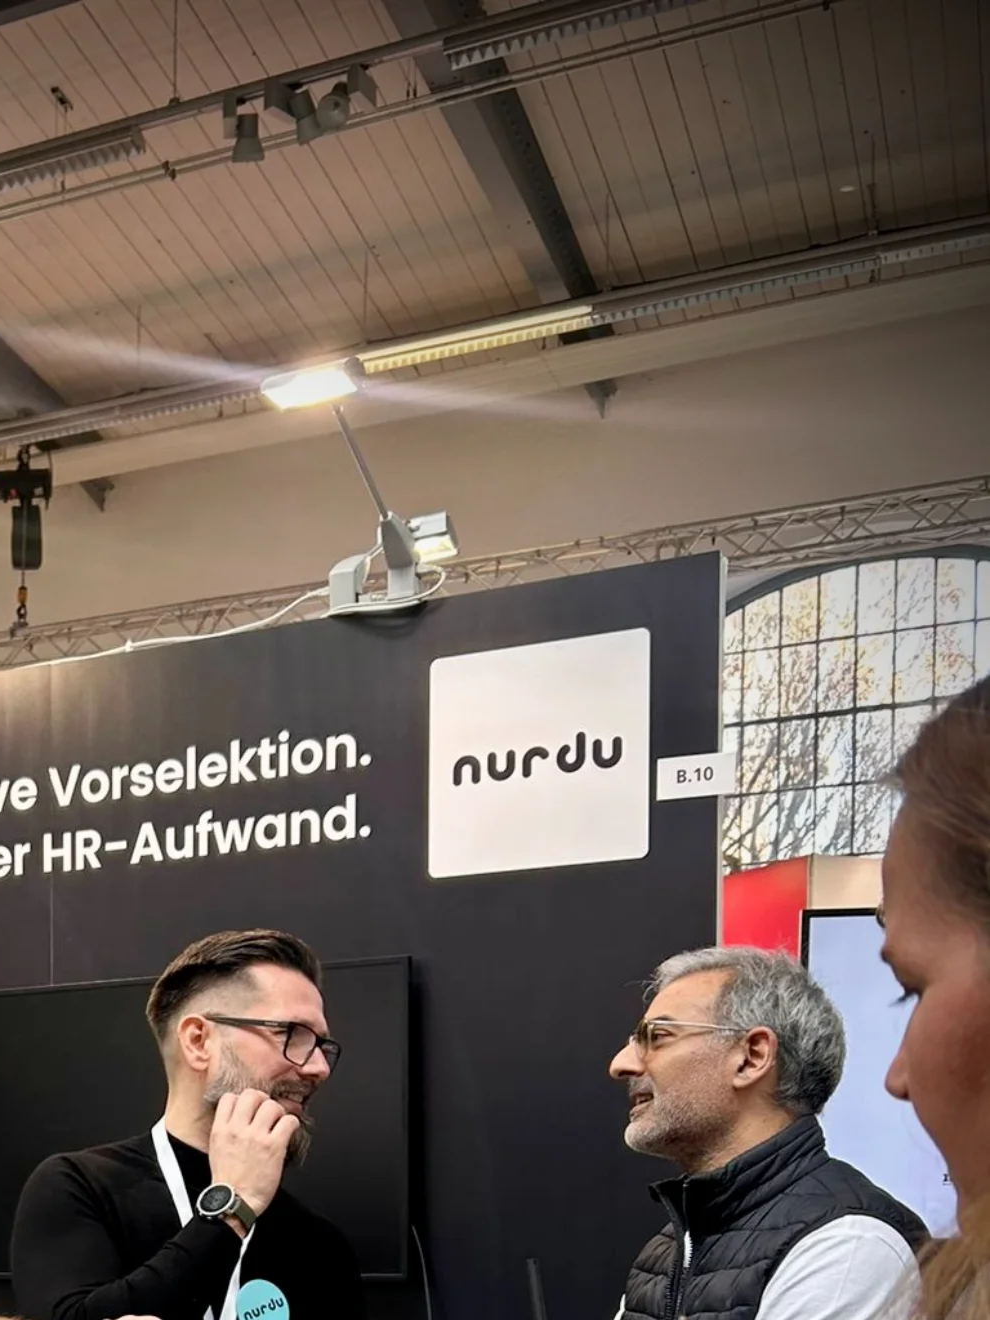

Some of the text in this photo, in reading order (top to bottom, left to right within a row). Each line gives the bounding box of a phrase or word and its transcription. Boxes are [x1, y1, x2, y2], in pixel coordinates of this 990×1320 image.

[49, 728, 372, 807] Vorselektion.
[452, 728, 625, 787] nurdu
[676, 766, 714, 785] B.10
[41, 793, 372, 872] HR-Aufwand.
